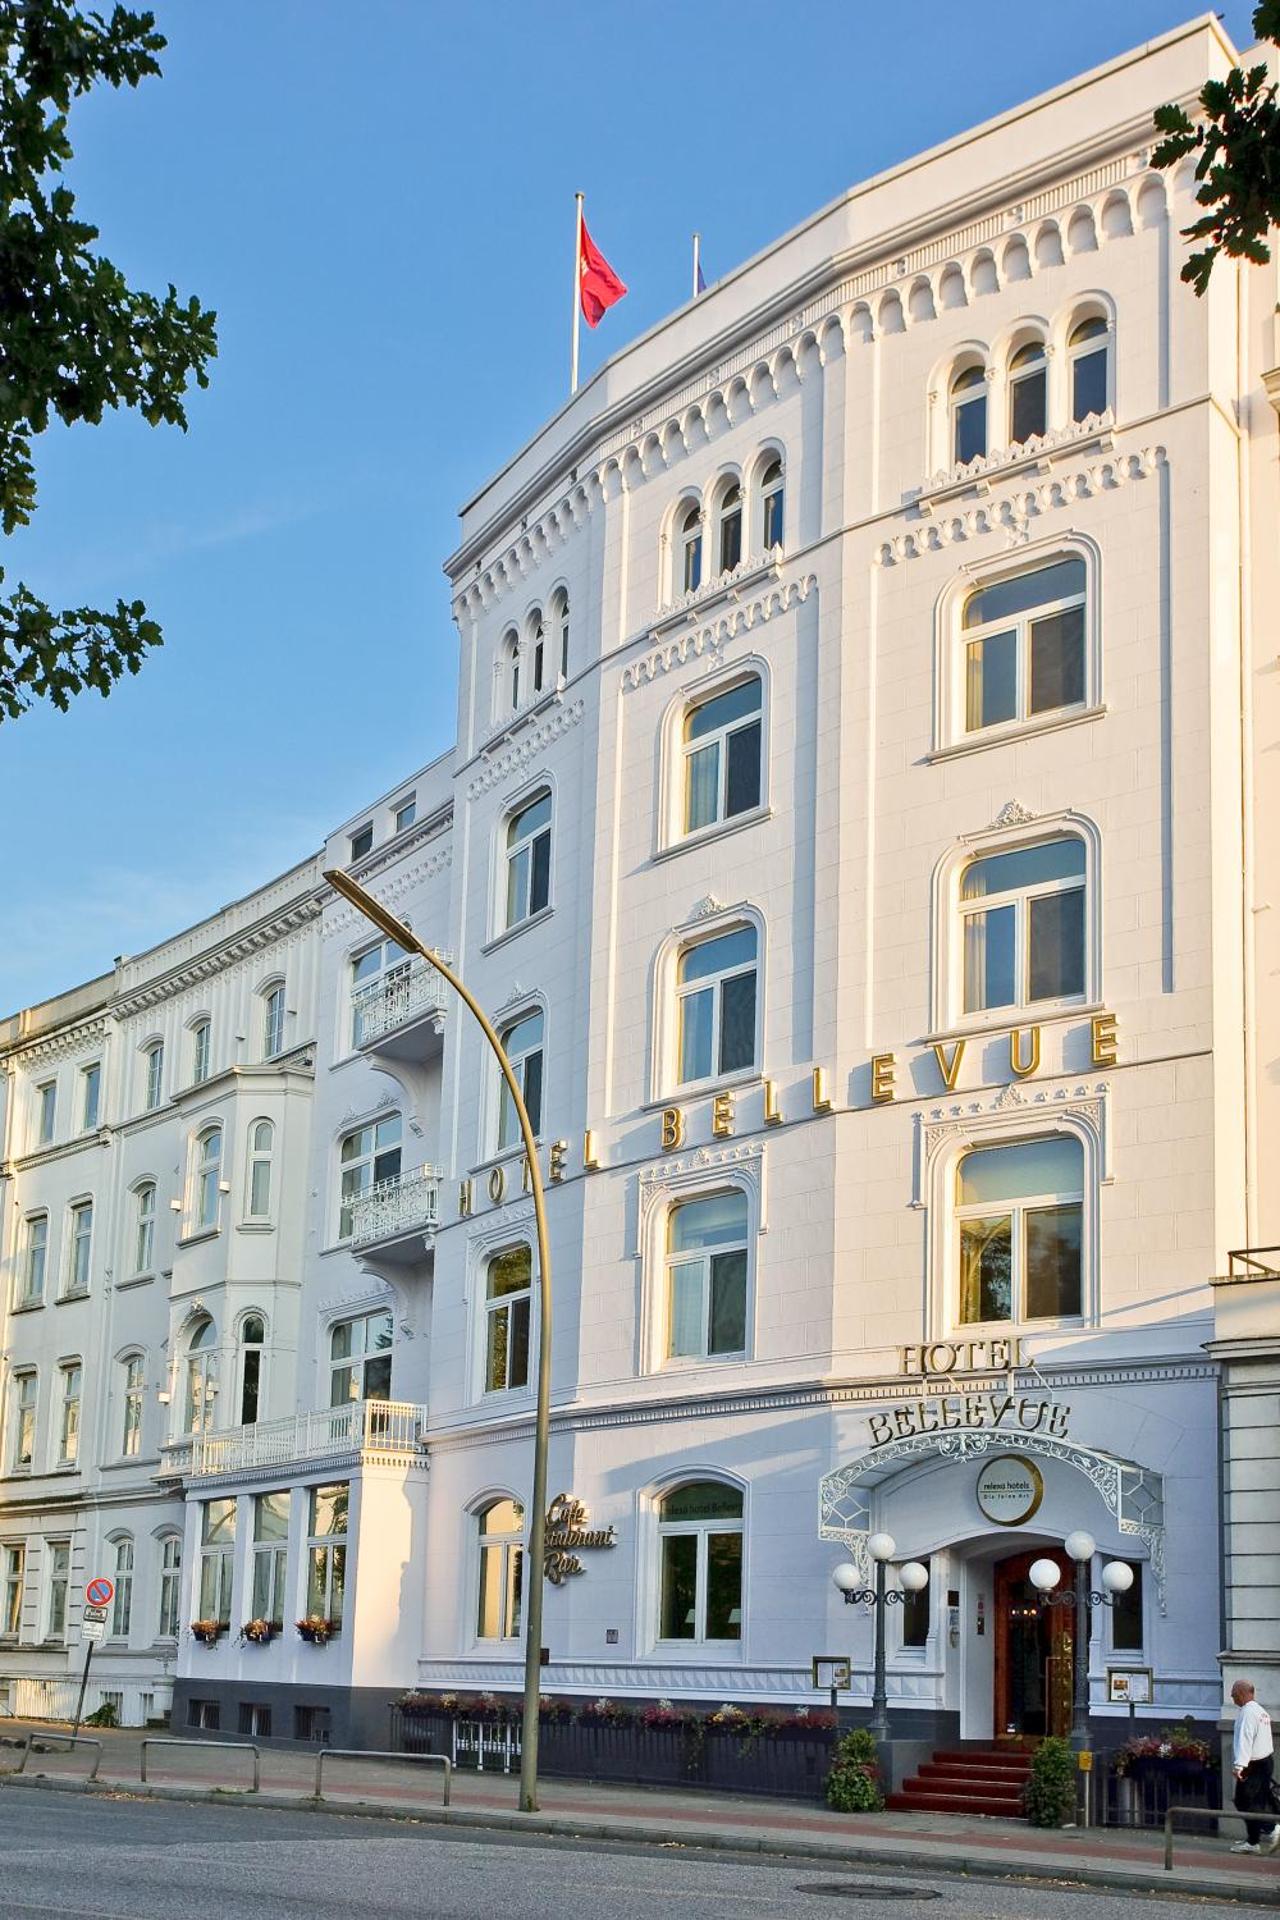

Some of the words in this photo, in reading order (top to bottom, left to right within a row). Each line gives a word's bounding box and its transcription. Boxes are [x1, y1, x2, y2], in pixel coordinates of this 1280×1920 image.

[458, 1129, 601, 1217] HOTEL
[662, 1012, 1117, 1152] BELLEVUE
[896, 1338, 1035, 1376] HOTEL
[862, 1395, 1071, 1450] BELLEVUE
[543, 1525, 618, 1549] staurant
